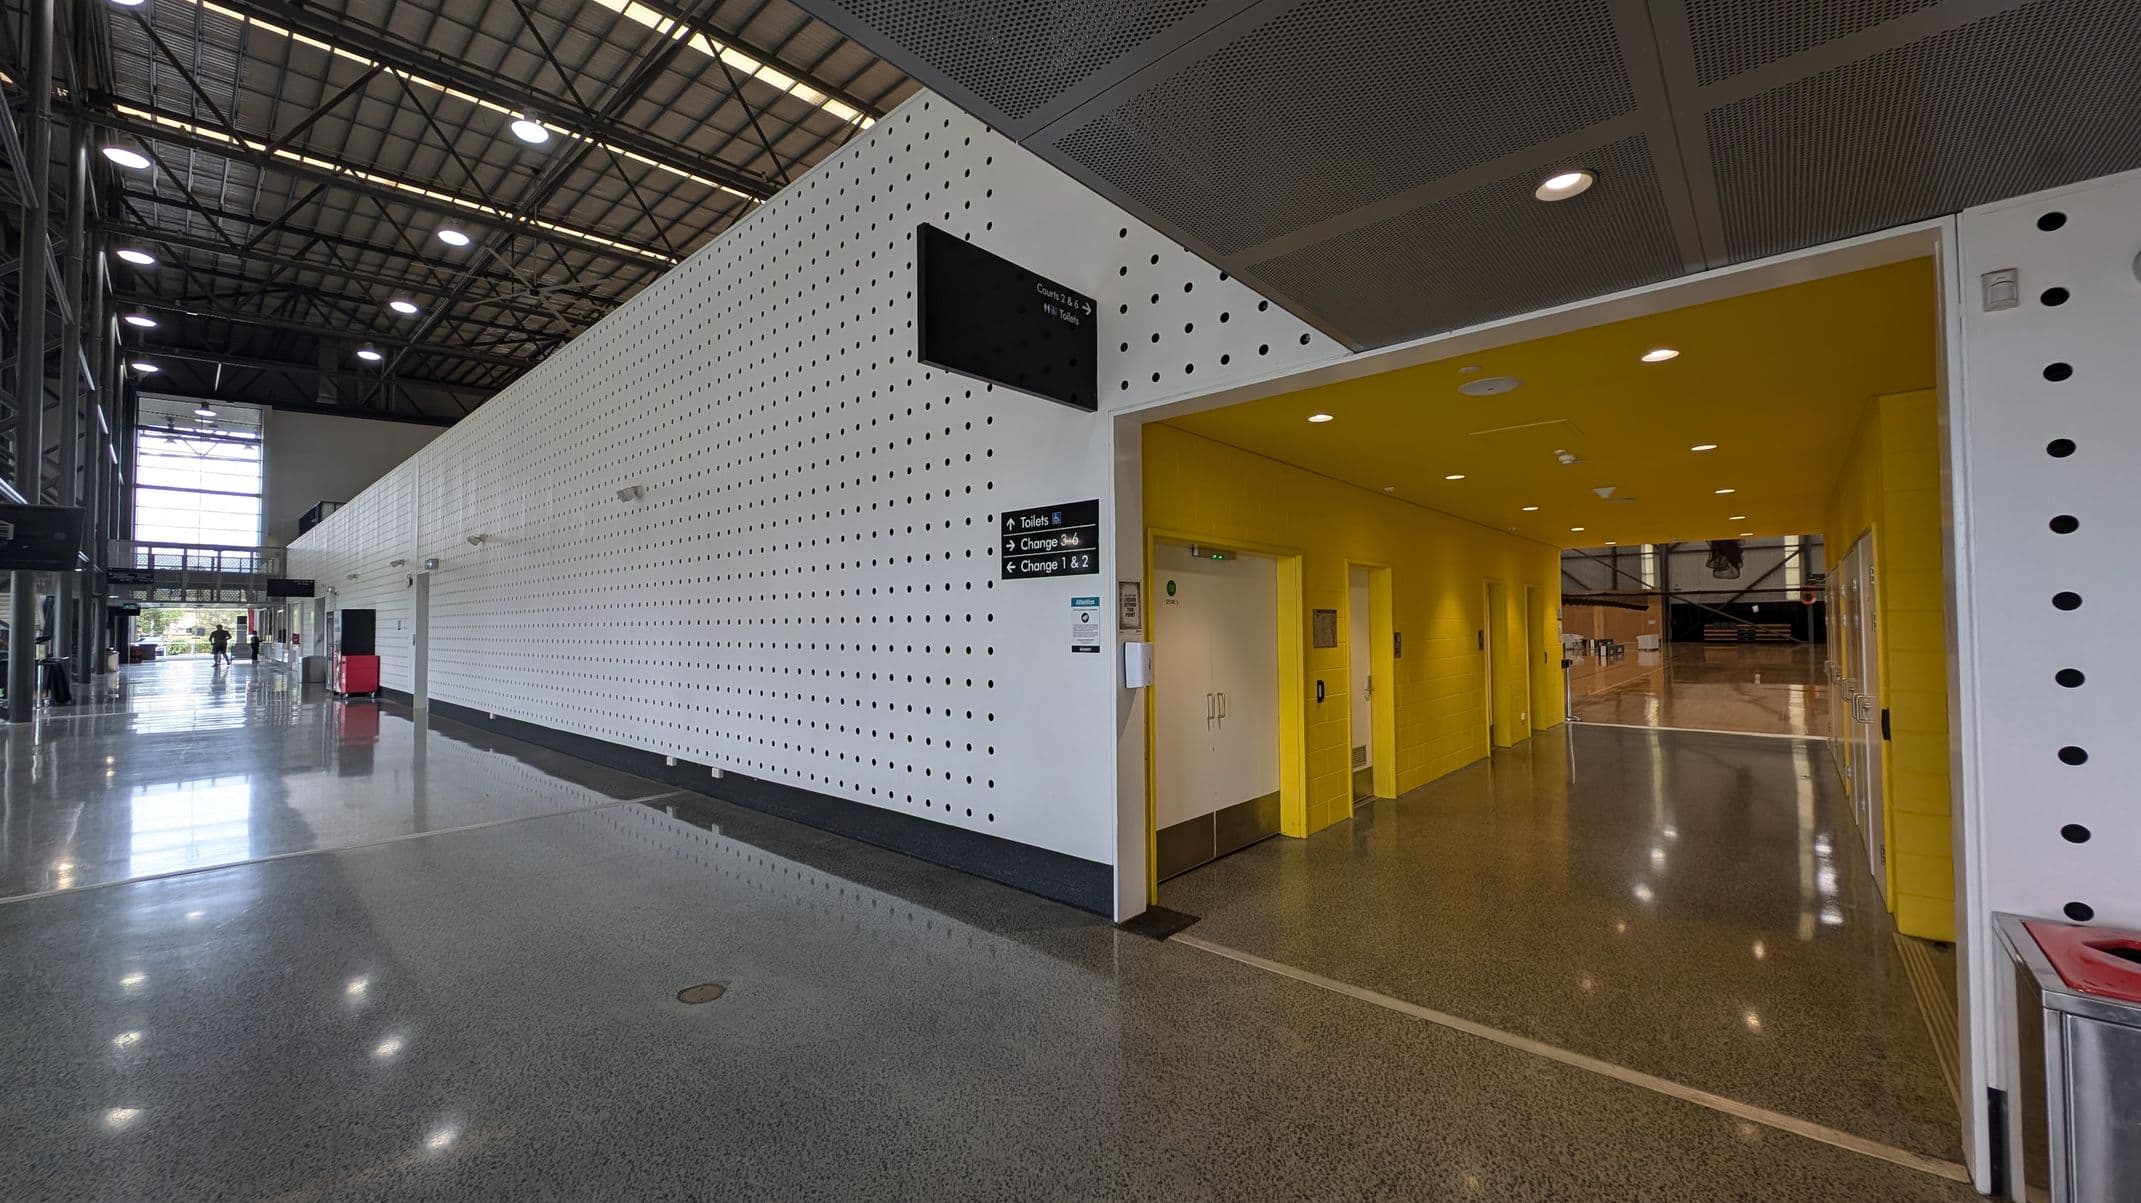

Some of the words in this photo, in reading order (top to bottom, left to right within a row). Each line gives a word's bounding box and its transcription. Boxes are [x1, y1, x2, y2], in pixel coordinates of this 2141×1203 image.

[1036, 283, 1059, 301] Courts
[1060, 293, 1066, 304] 2
[1059, 309, 1079, 326] Toilets
[1020, 515, 1049, 528] Toilets
[1020, 537, 1058, 551] Change
[1020, 559, 1058, 573] Change
[1061, 556, 1066, 569] 1
[1070, 555, 1079, 568] &
[1081, 555, 1089, 568] 2
